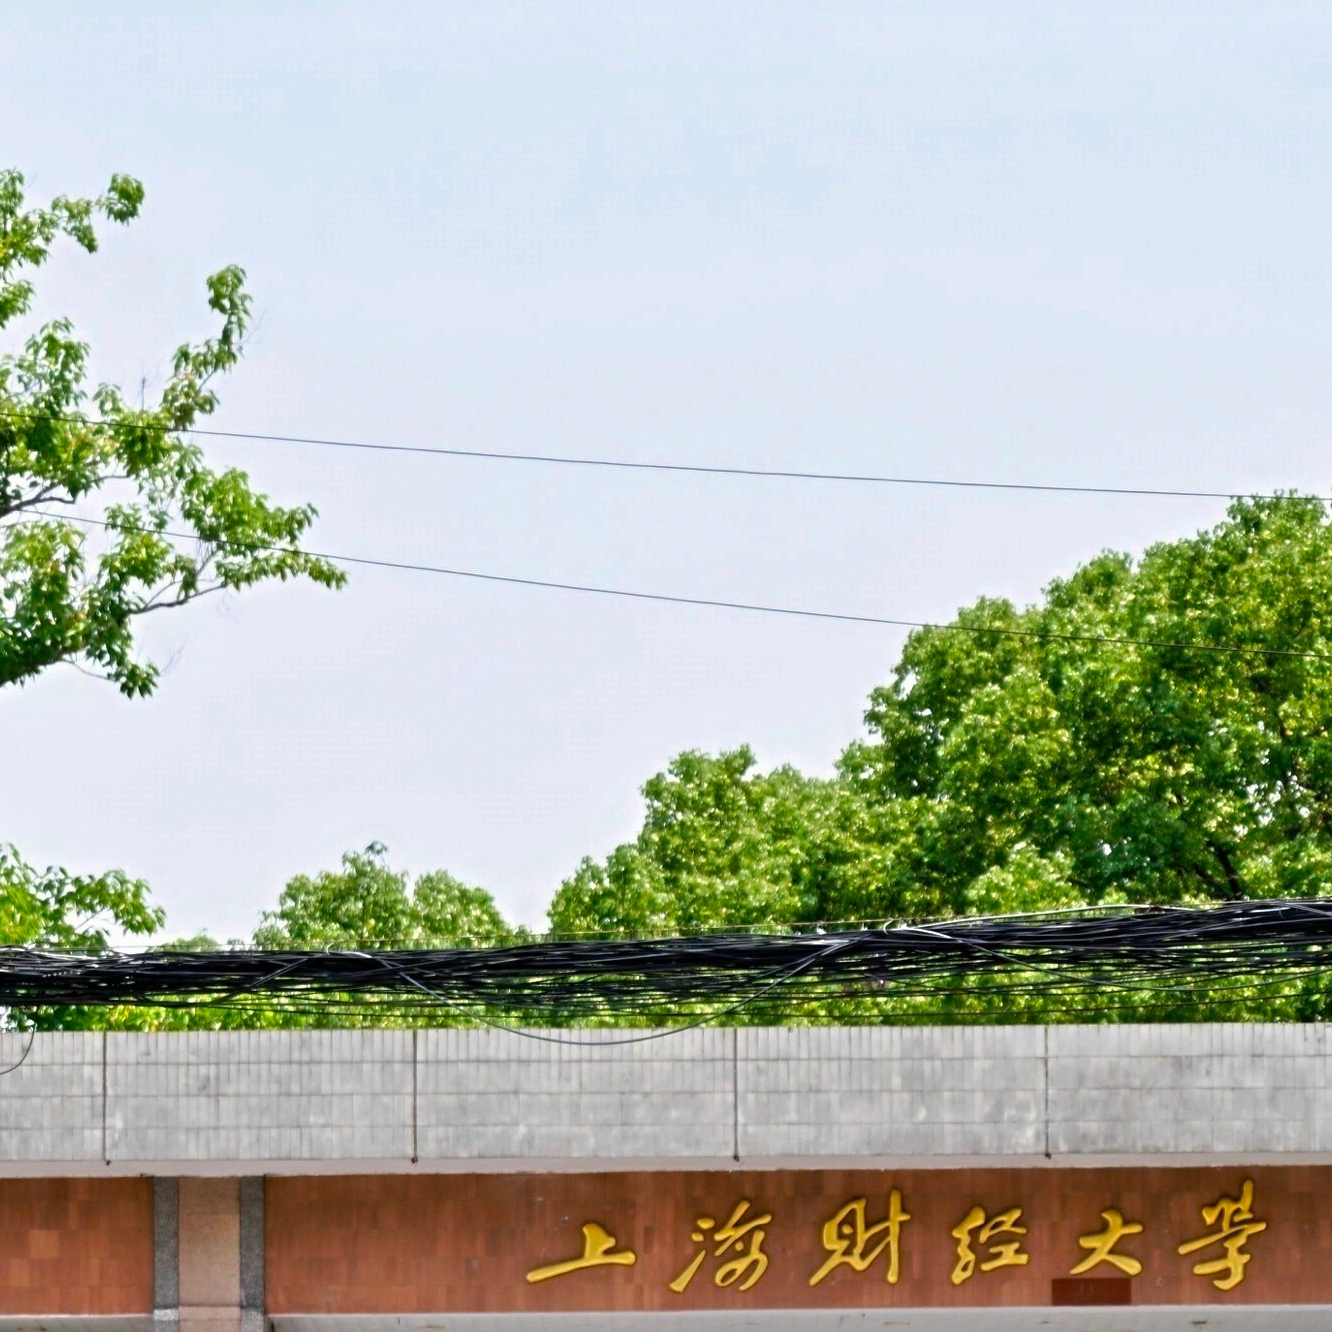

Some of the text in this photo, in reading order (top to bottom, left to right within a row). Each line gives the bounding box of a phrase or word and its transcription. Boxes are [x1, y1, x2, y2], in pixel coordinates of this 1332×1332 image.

[525, 1178, 1268, 1293] 上海财经大学
